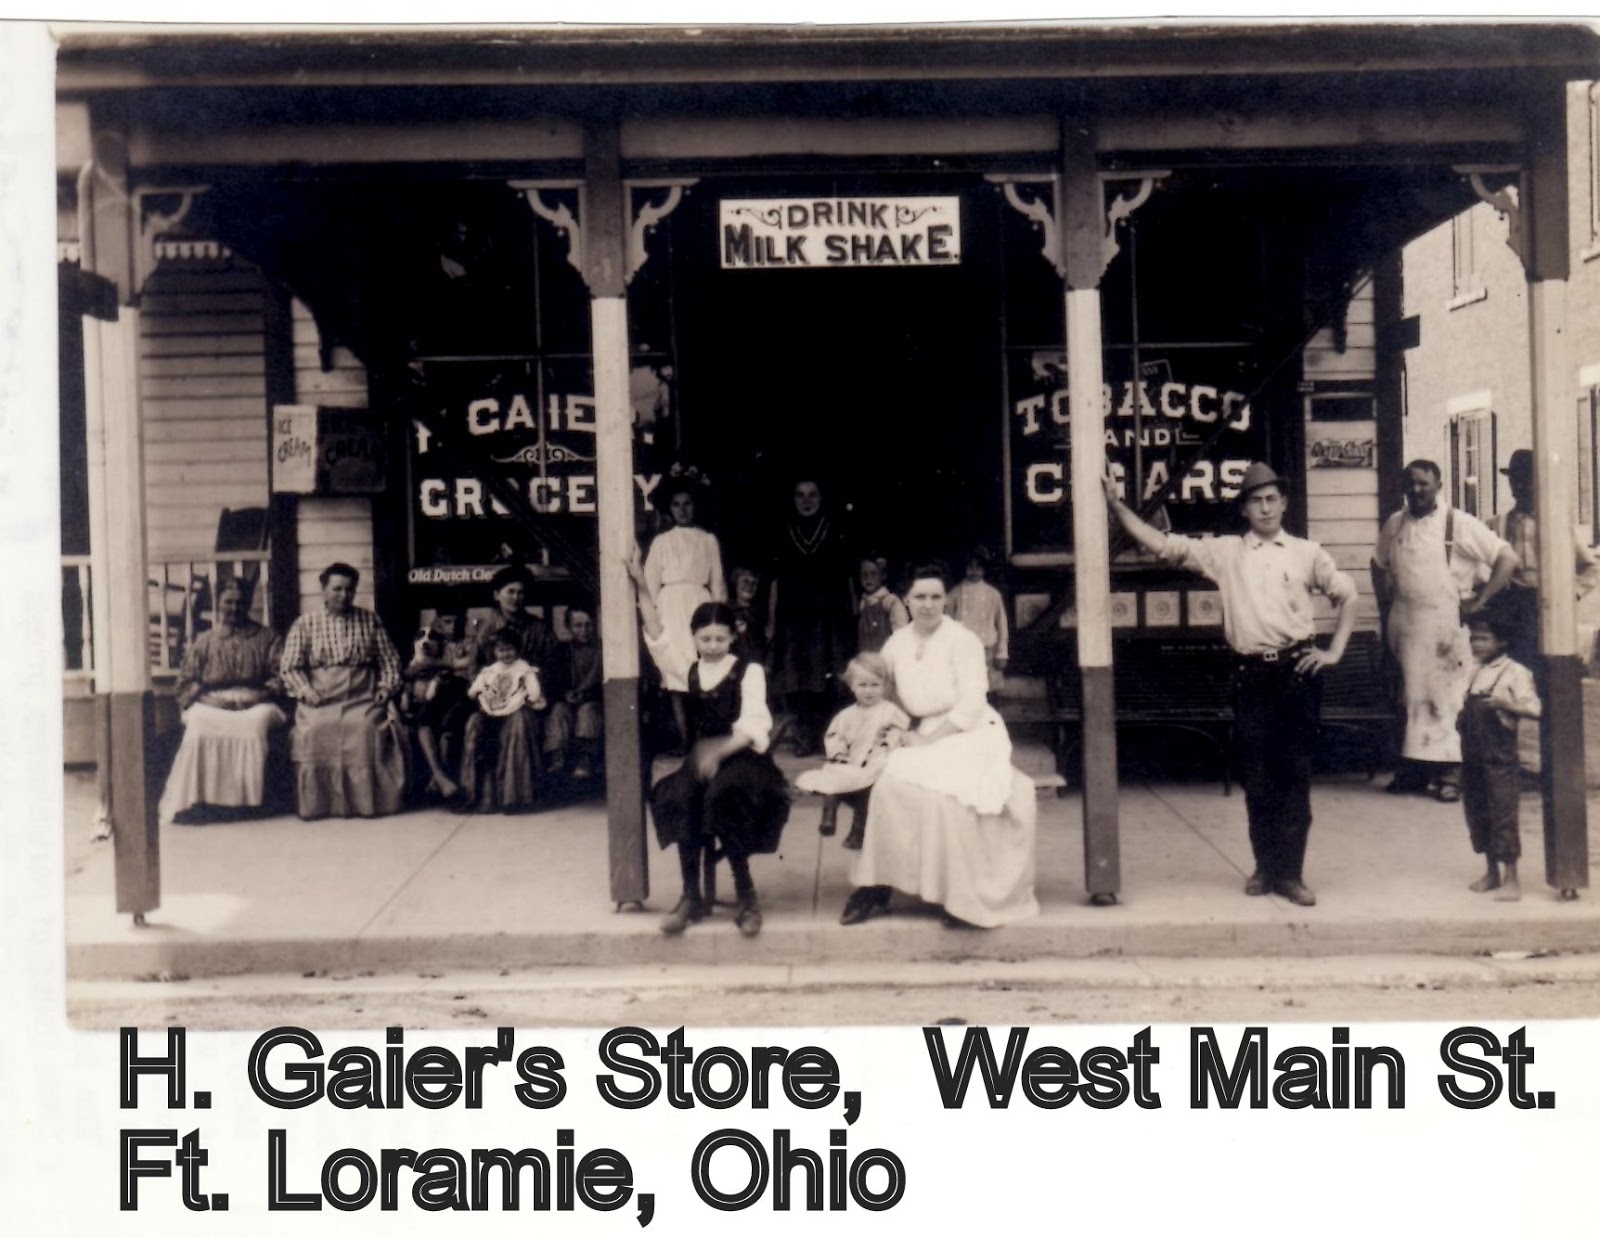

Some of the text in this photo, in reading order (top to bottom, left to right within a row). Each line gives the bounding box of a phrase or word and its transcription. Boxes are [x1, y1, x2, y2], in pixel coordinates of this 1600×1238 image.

[787, 202, 889, 228] DRINK
[724, 224, 959, 264] MILK SHAKE.
[1103, 428, 1171, 448] AND
[419, 474, 662, 518] GRCEY
[1026, 459, 1251, 503] CARS
